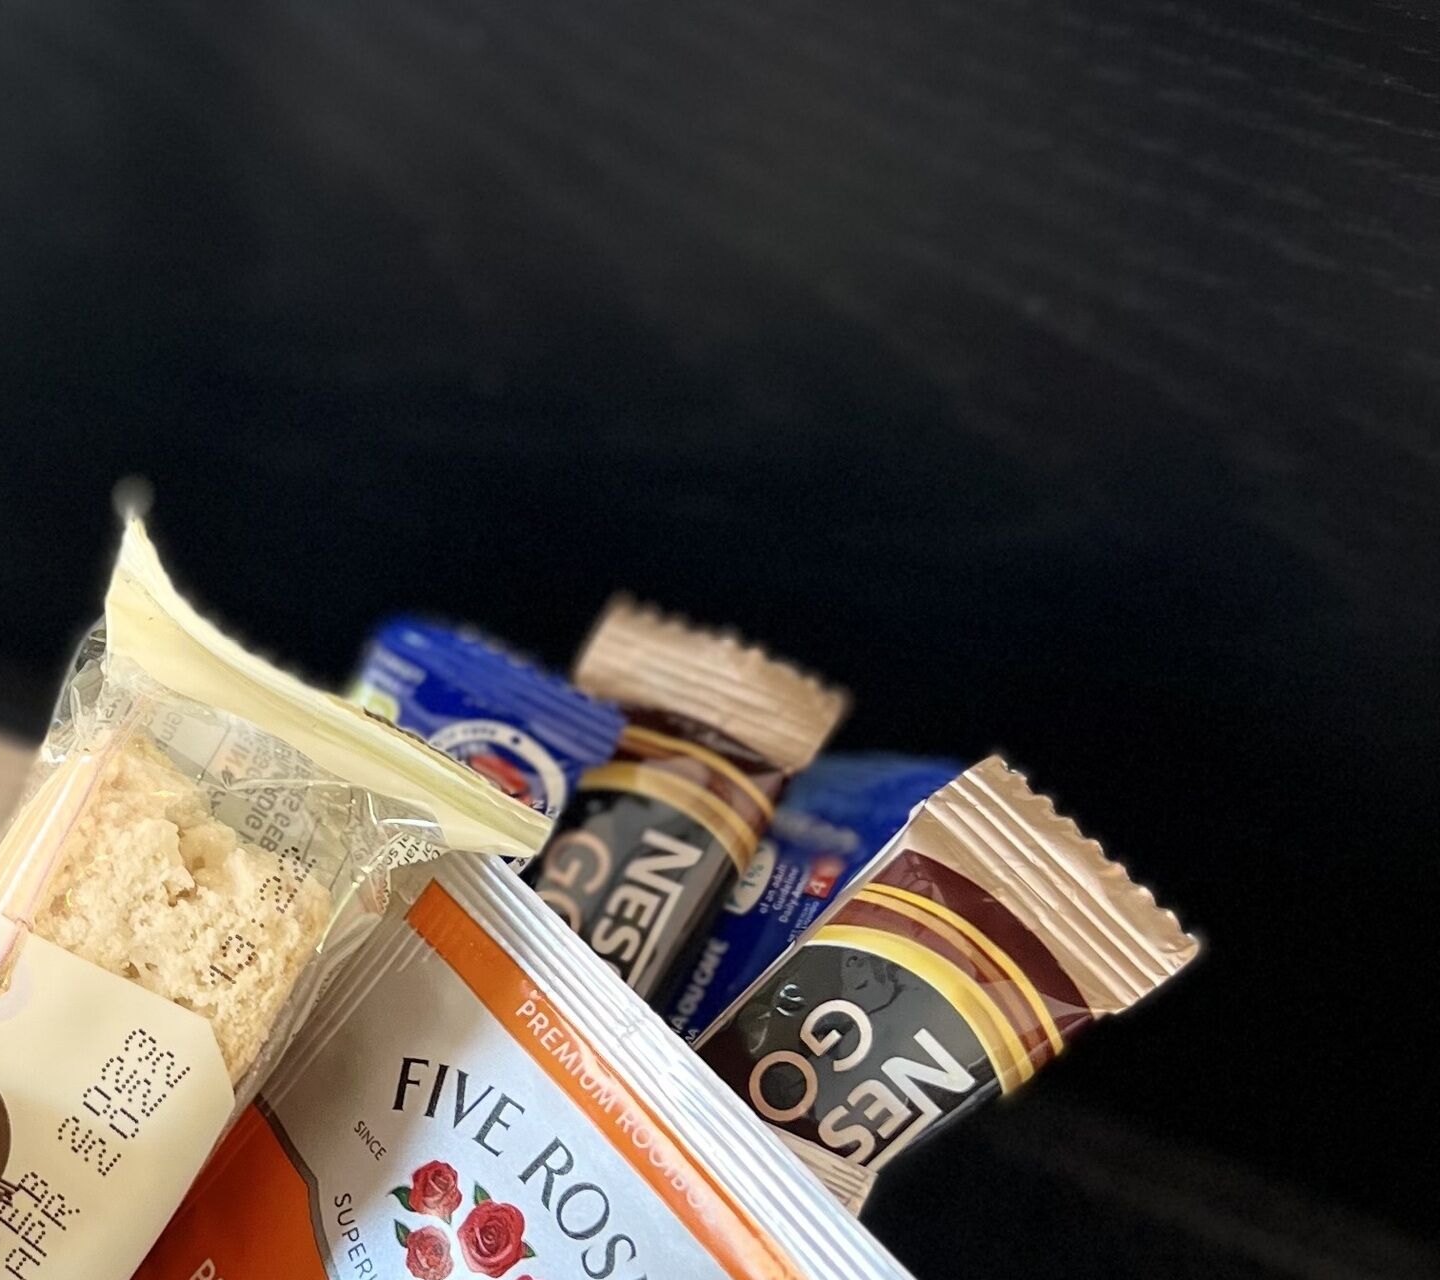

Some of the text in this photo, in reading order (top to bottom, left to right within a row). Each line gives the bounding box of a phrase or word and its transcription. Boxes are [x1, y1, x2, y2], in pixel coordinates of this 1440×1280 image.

[96, 1057, 192, 1178] 2022
[208, 845, 317, 988] 13:22
[515, 1000, 617, 1114] PREMIUM
[56, 1028, 160, 1158] 2023
[353, 1120, 387, 1162] SINCE
[392, 1057, 525, 1157] FIVE
